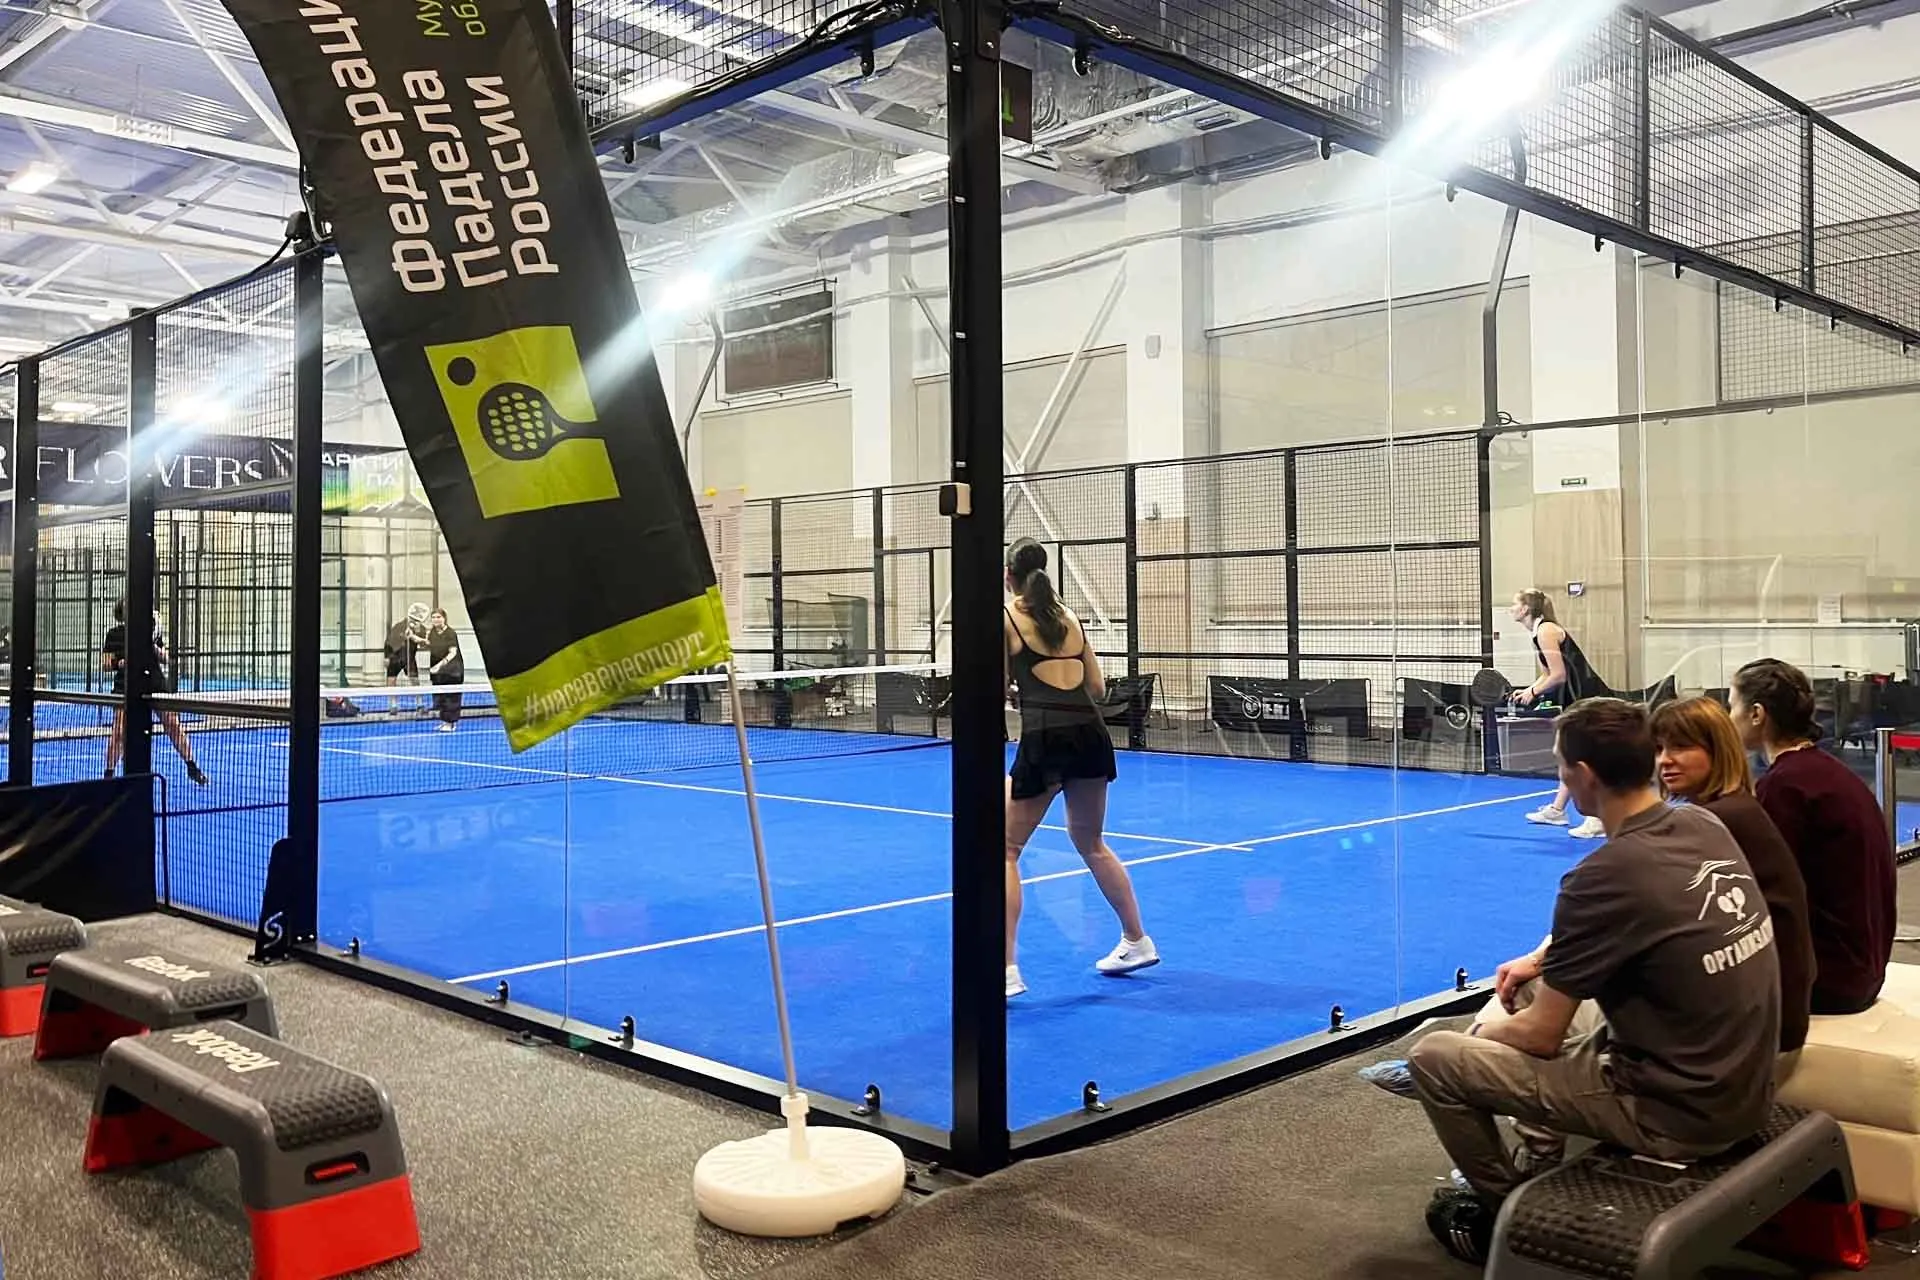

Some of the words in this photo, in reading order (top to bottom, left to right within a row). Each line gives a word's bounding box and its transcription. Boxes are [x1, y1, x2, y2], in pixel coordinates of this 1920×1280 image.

[451, 0, 487, 36] об
[402, 69, 508, 288] Падела
[465, 75, 559, 275] России
[171, 1029, 281, 1073] Reebok
